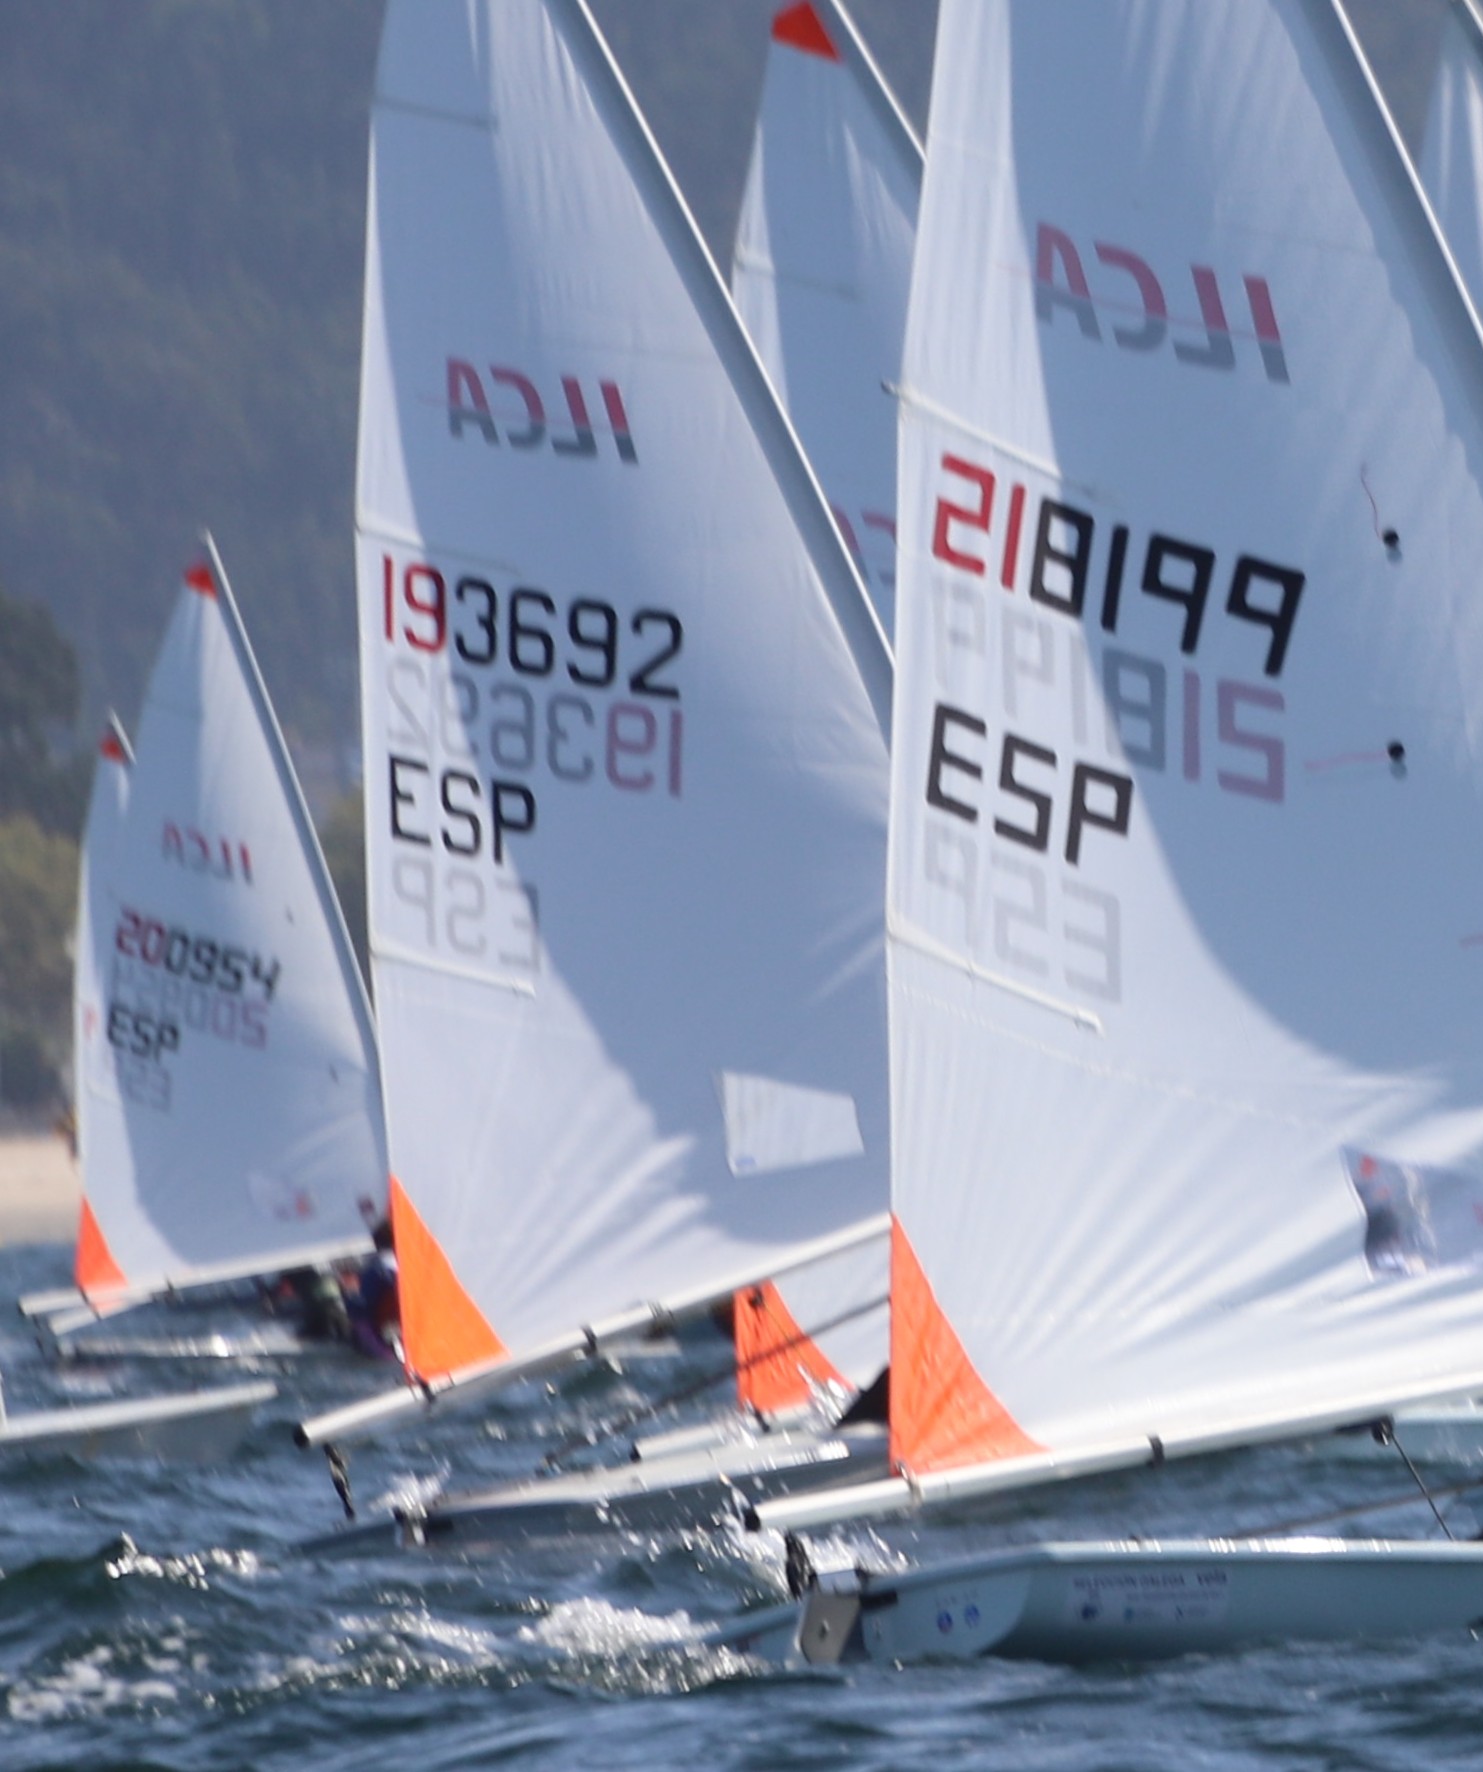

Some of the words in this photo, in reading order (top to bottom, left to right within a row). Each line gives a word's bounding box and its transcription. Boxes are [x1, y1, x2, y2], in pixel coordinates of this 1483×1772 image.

[382, 555, 683, 700] 193692
[932, 452, 1305, 677] 218199
[387, 754, 536, 865] ESP
[925, 702, 1133, 866] ESP
[116, 906, 281, 1004] 200954
[107, 1000, 180, 1062] ESP
